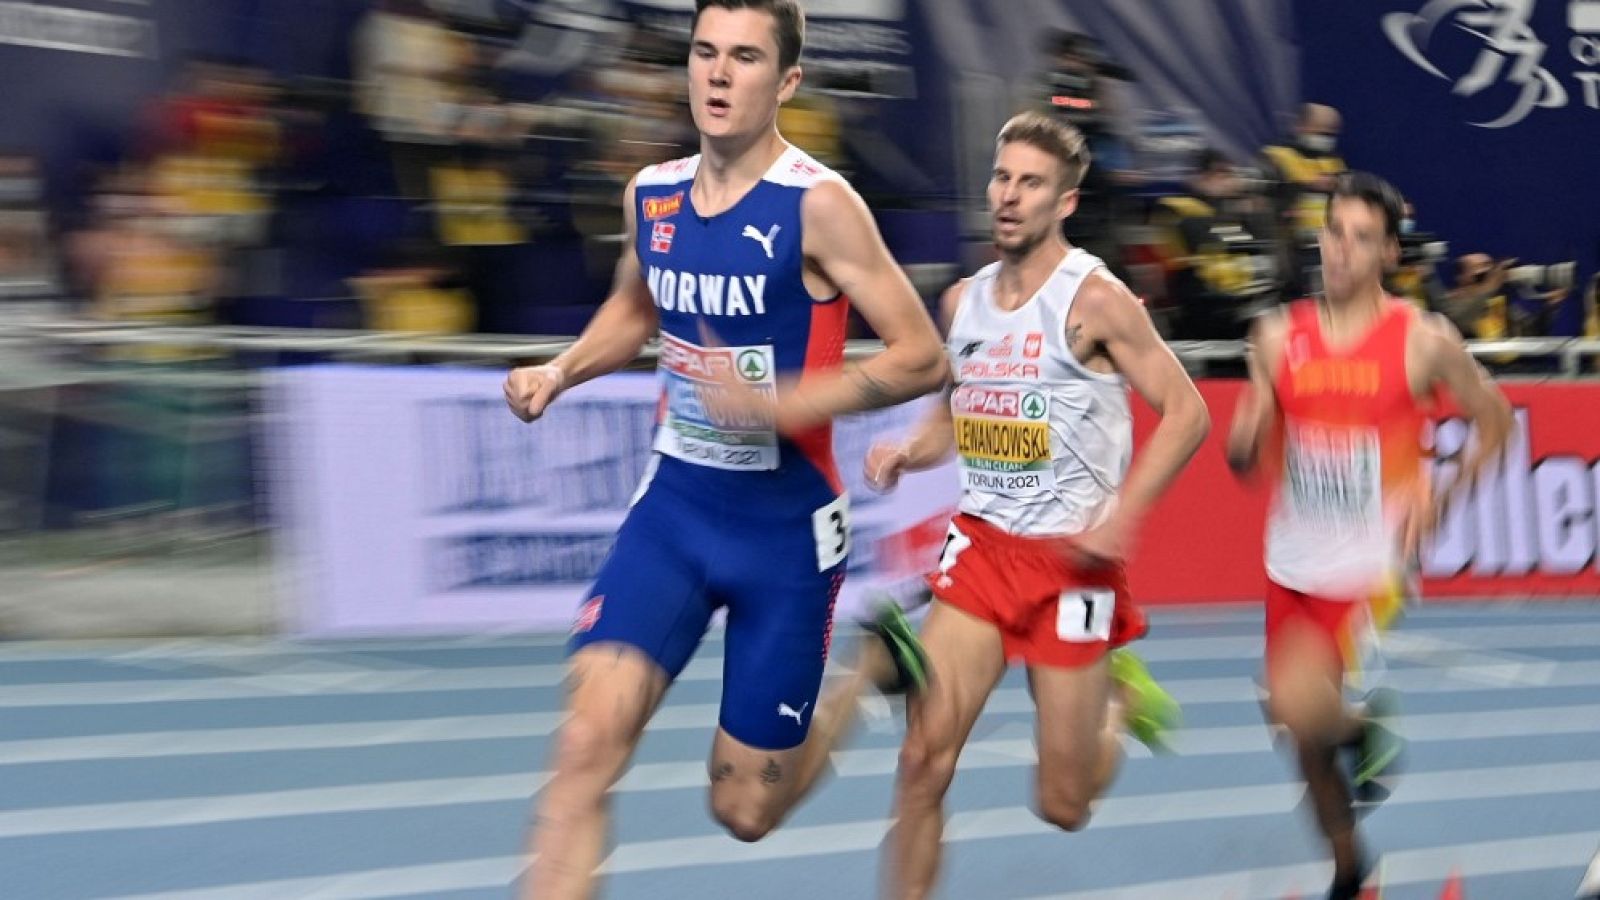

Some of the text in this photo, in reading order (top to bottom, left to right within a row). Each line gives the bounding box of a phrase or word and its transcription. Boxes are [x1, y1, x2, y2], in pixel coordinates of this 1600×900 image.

[648, 265, 766, 317] NORWAY
[960, 361, 1039, 378] POLSKA
[955, 388, 1017, 416] SPAR
[958, 420, 1049, 459] LEWANDOWSKI
[1007, 474, 1041, 489] 2021
[830, 510, 847, 555] 3
[1080, 593, 1095, 633] 1
